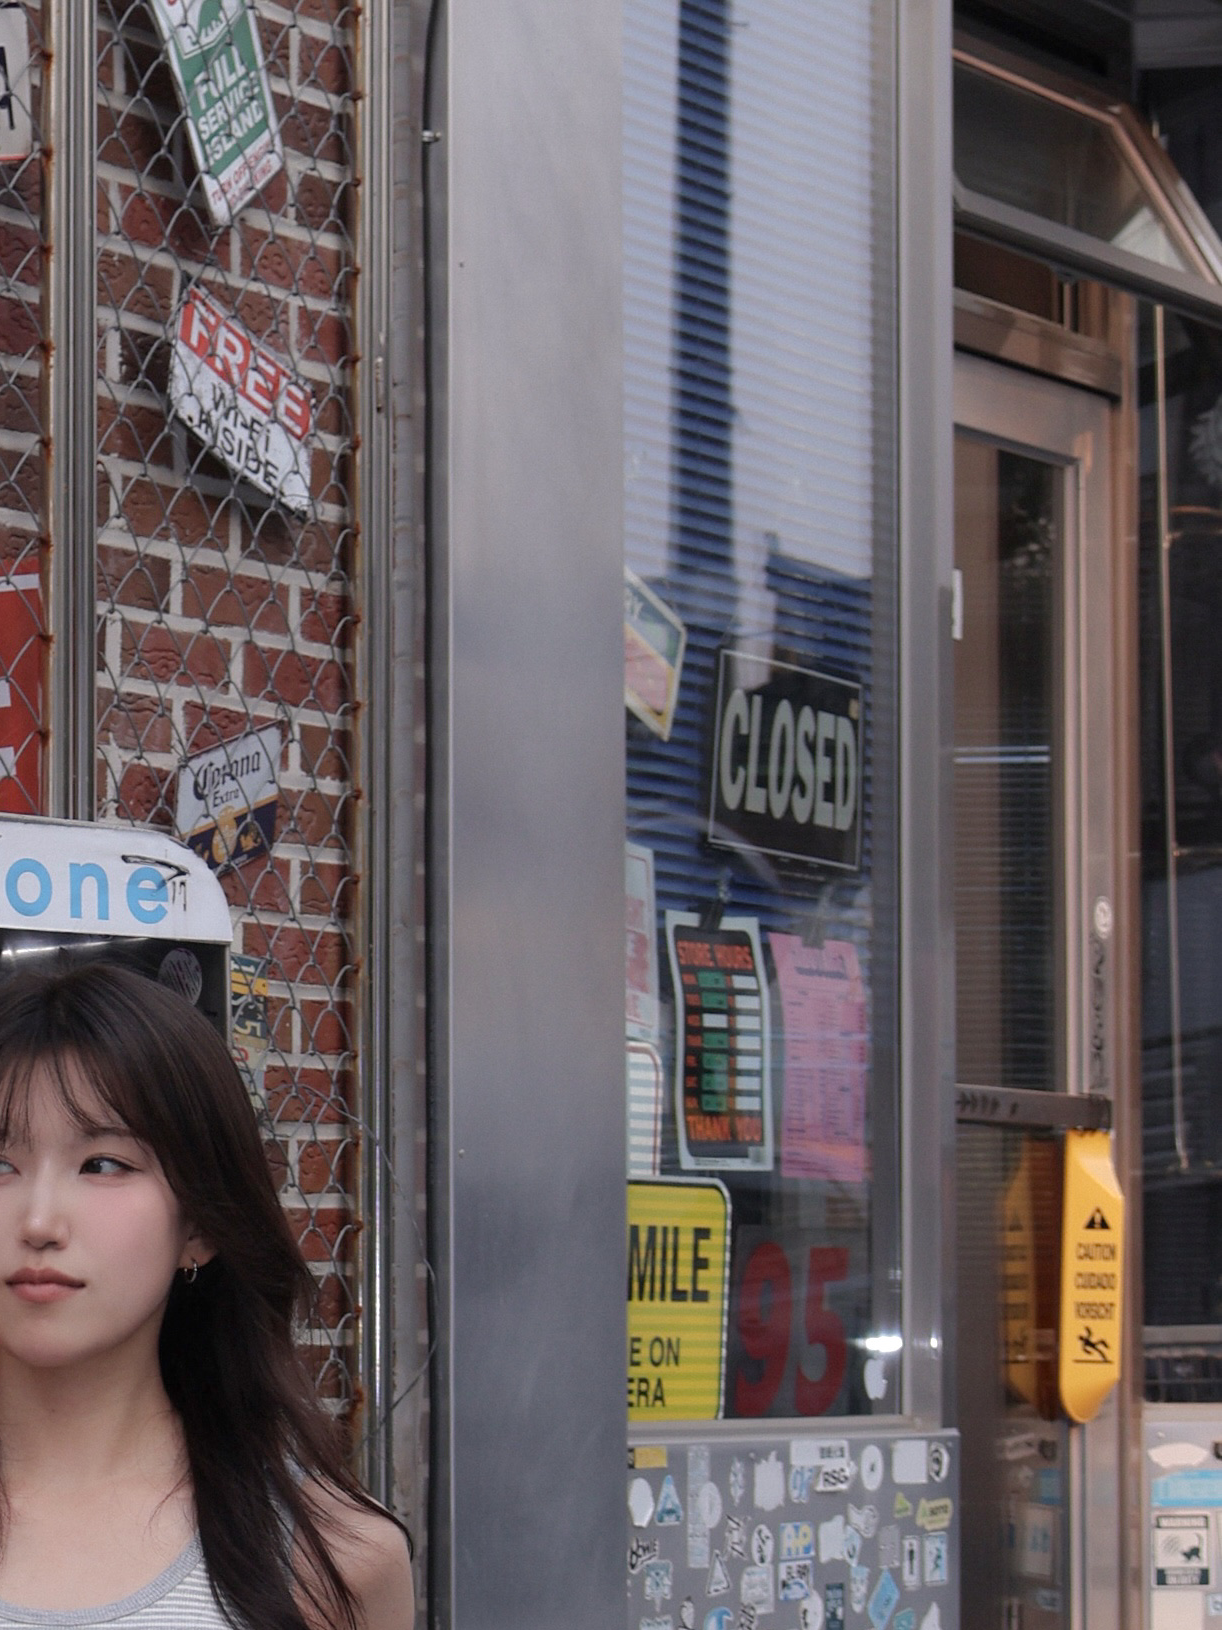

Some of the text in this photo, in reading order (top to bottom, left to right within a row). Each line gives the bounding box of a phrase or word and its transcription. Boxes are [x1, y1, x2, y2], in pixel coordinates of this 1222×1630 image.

[193, 45, 249, 110] FULL
[198, 70, 260, 140] SERVICE
[204, 99, 265, 165] ISLAND
[189, 296, 307, 436] FREE
[193, 751, 261, 801] Corona
[719, 687, 857, 832] CLOSED
[212, 788, 240, 808] Extra
[649, 1336, 681, 1367] ON
[734, 1241, 850, 1417] 95
